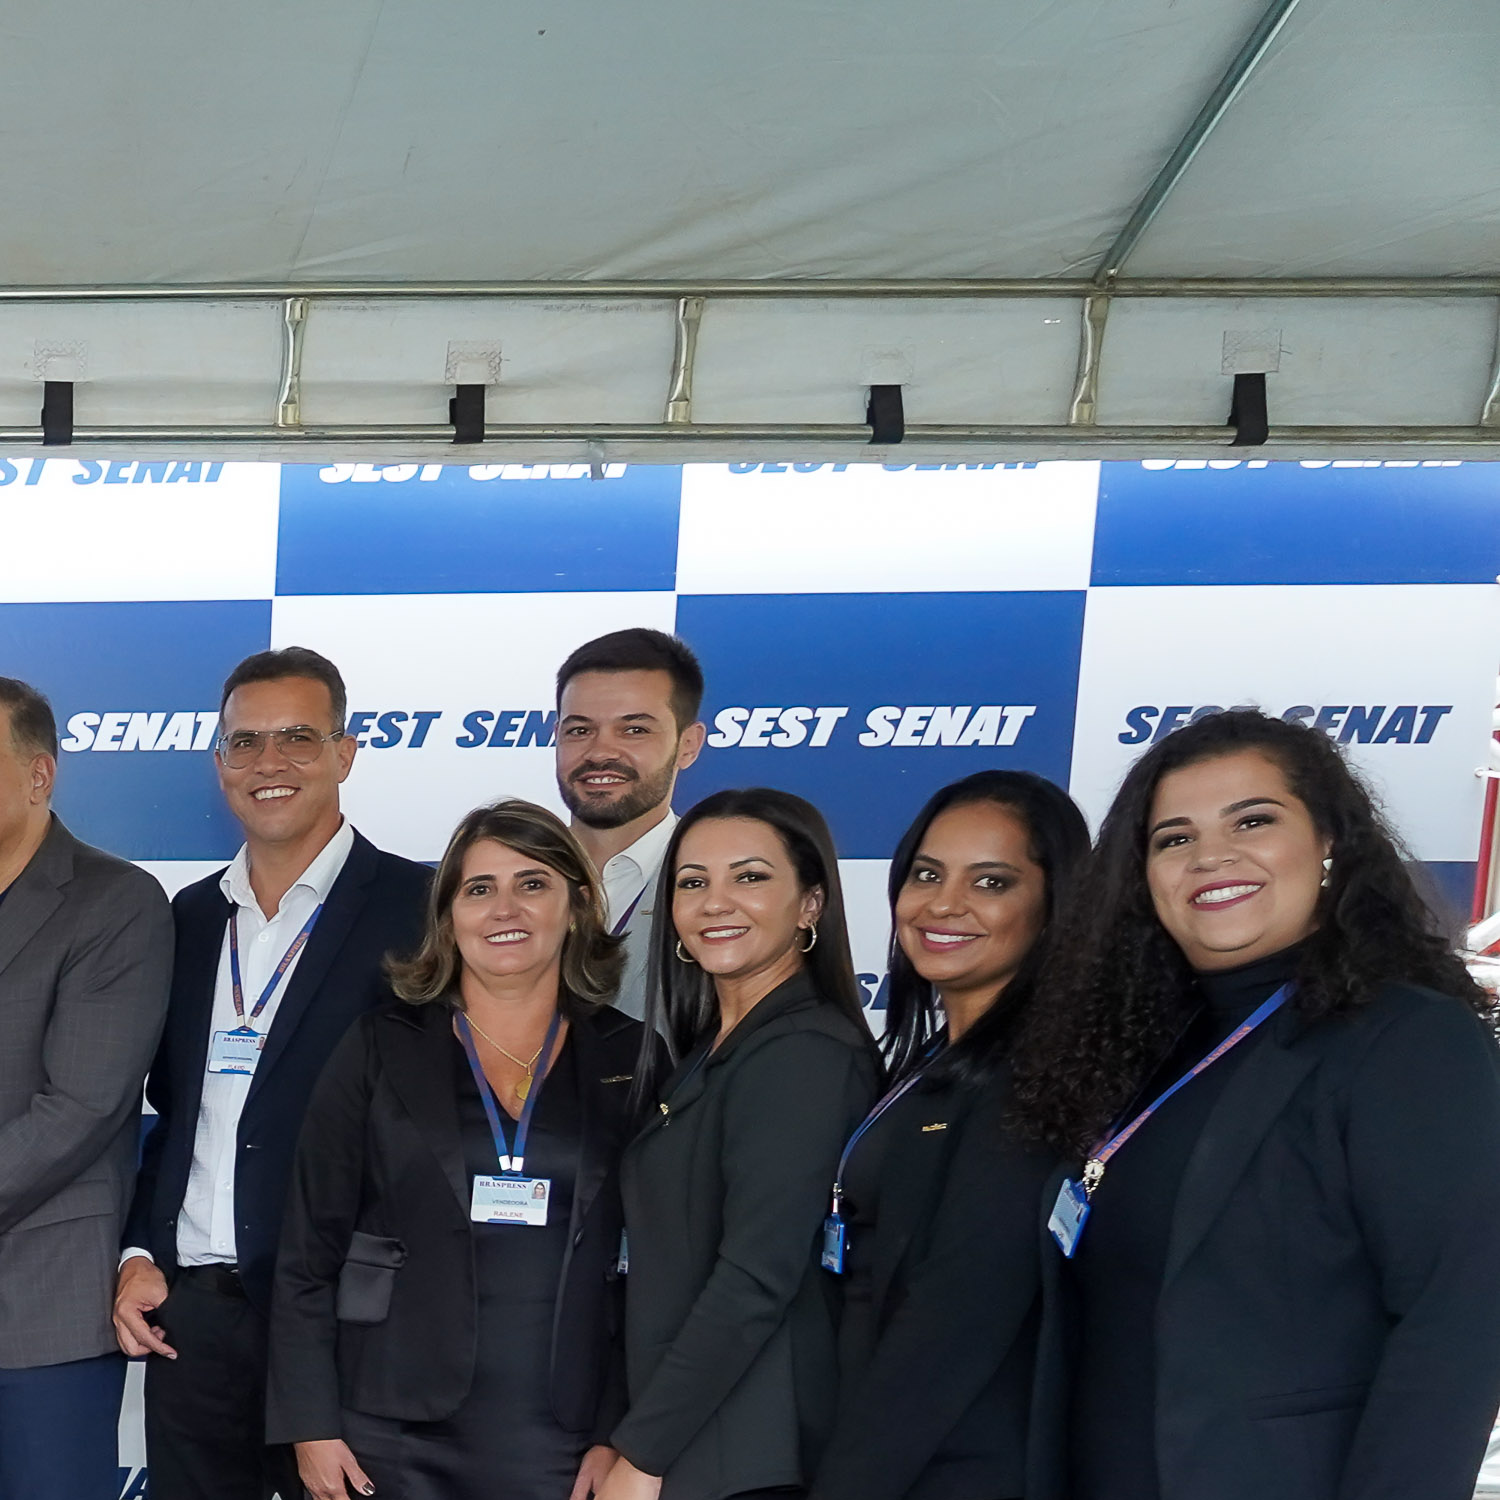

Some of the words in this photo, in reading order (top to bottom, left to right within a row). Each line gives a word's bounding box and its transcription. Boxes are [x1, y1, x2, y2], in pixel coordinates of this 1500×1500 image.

[349, 710, 443, 749] EST
[706, 705, 850, 749] SEST
[858, 704, 1037, 748] SENAT
